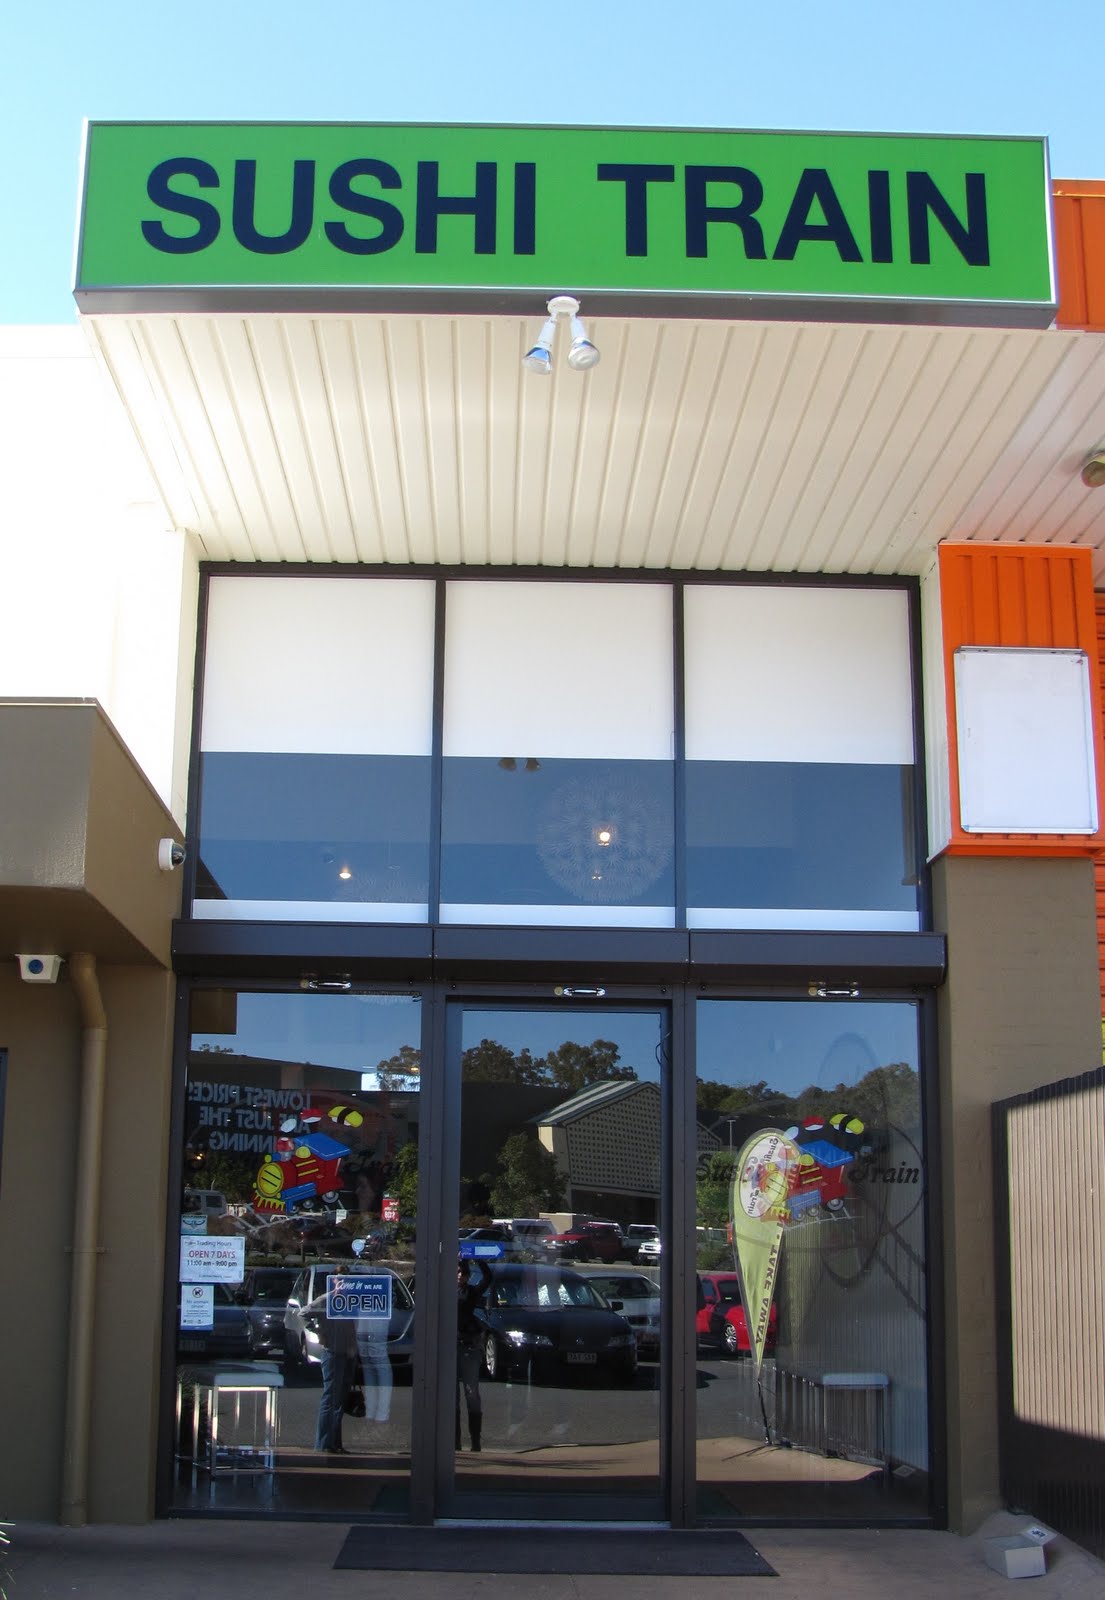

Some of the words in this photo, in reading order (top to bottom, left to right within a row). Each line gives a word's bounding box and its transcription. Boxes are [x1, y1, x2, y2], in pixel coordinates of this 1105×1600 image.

[140, 157, 537, 255] SUSHI
[597, 163, 991, 267] TRAIN
[189, 1250, 209, 1258] OPEN
[211, 1250, 216, 1258] 7
[217, 1250, 236, 1259] DAYS
[187, 1259, 202, 1267] 11:00
[335, 1279, 355, 1290] Come
[355, 1280, 363, 1290] in
[331, 1294, 387, 1312] OPEN
